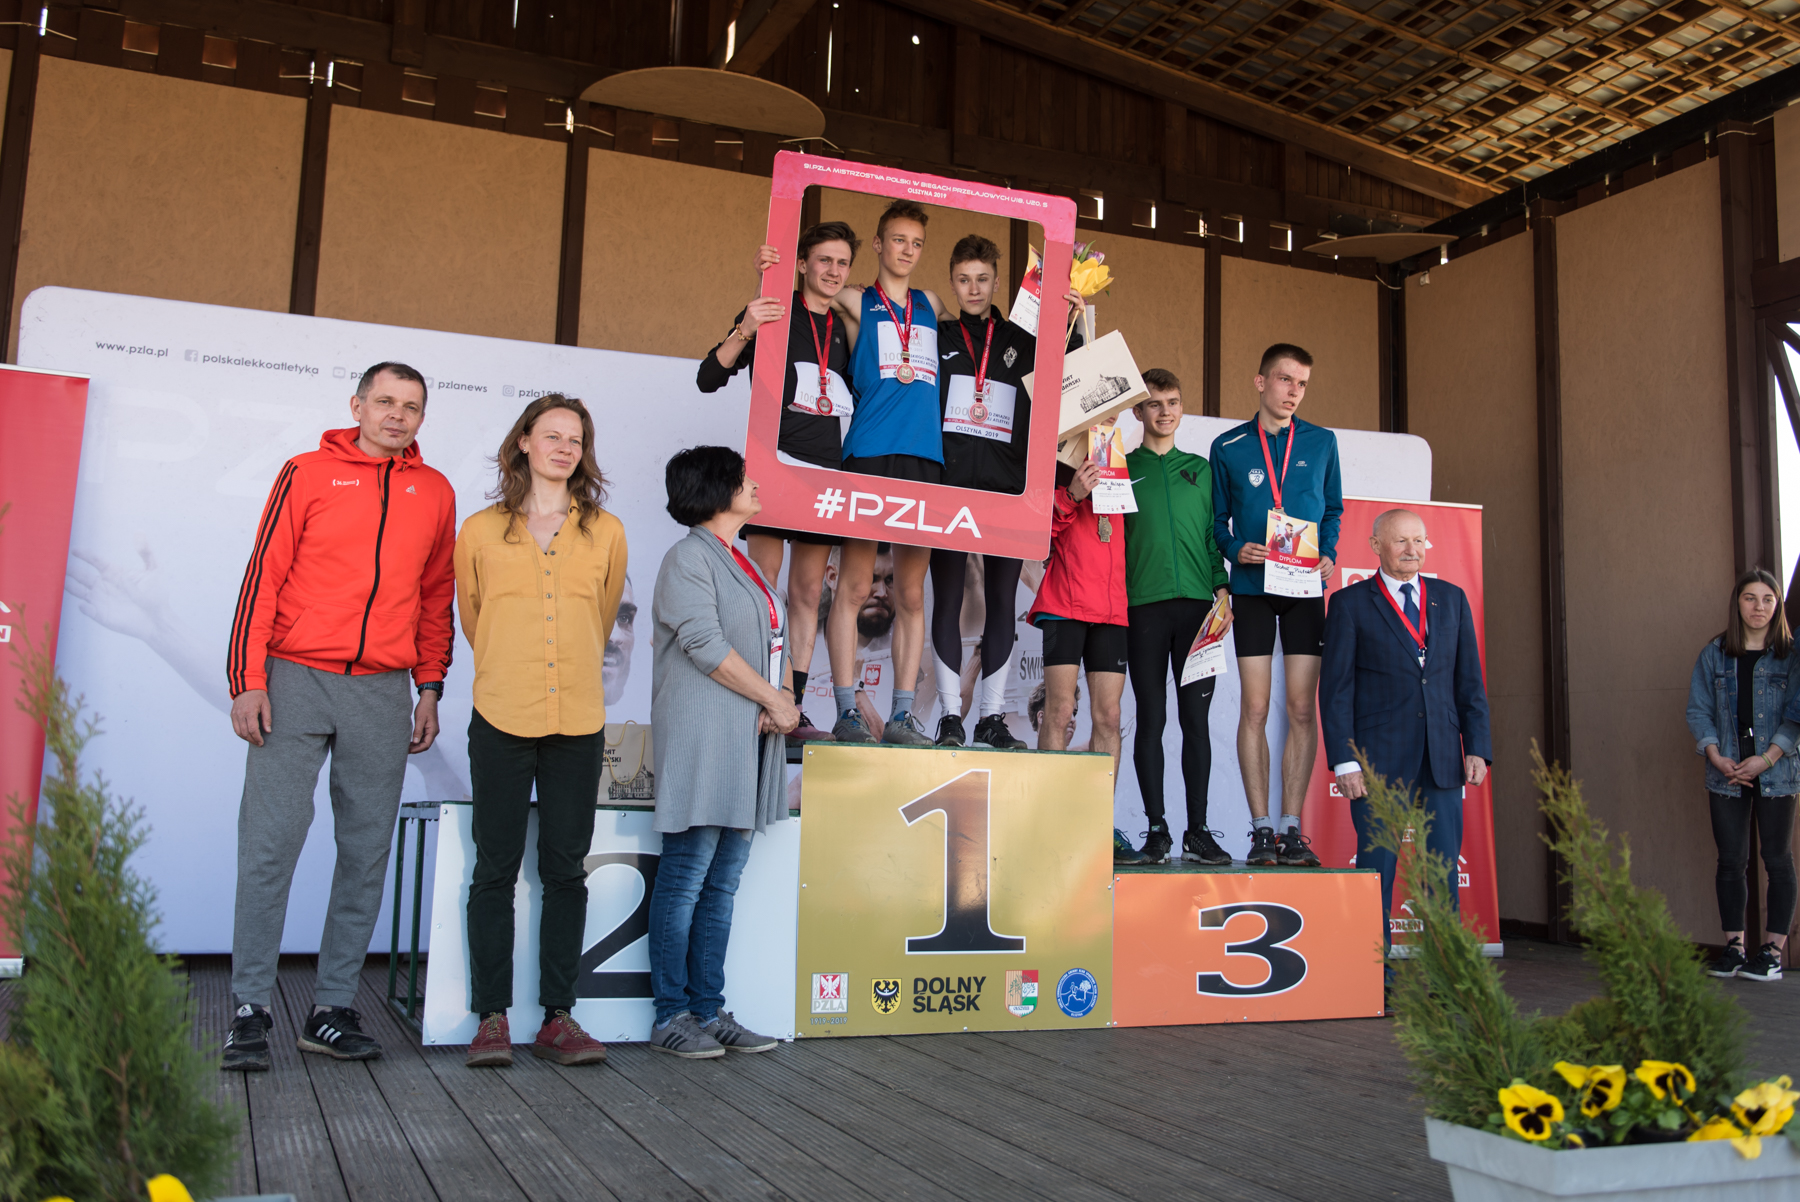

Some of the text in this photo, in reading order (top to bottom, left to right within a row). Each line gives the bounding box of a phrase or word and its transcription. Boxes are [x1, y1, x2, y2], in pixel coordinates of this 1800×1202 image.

[833, 168, 885, 181] MISTRZOSTWA
[886, 176, 911, 185] POLSKI
[921, 182, 952, 192] BIEGACH
[907, 187, 933, 197] OLSZYNA
[96, 341, 168, 358] www.pzla.pl
[203, 353, 319, 375] polskalekkoatletyka
[438, 380, 488, 393] pzlanews
[800, 391, 815, 405] 100
[950, 405, 968, 416] 100
[985, 430, 999, 438] 2019
[814, 487, 982, 538] #PZLA
[1279, 554, 1302, 565] DYPLOM
[898, 769, 1026, 954] 1
[576, 852, 660, 998] 2
[1196, 901, 1309, 998] 3
[913, 976, 986, 995] DOLNY
[813, 1000, 846, 1012] PZLA
[912, 992, 981, 1014] ŚLĄSK
